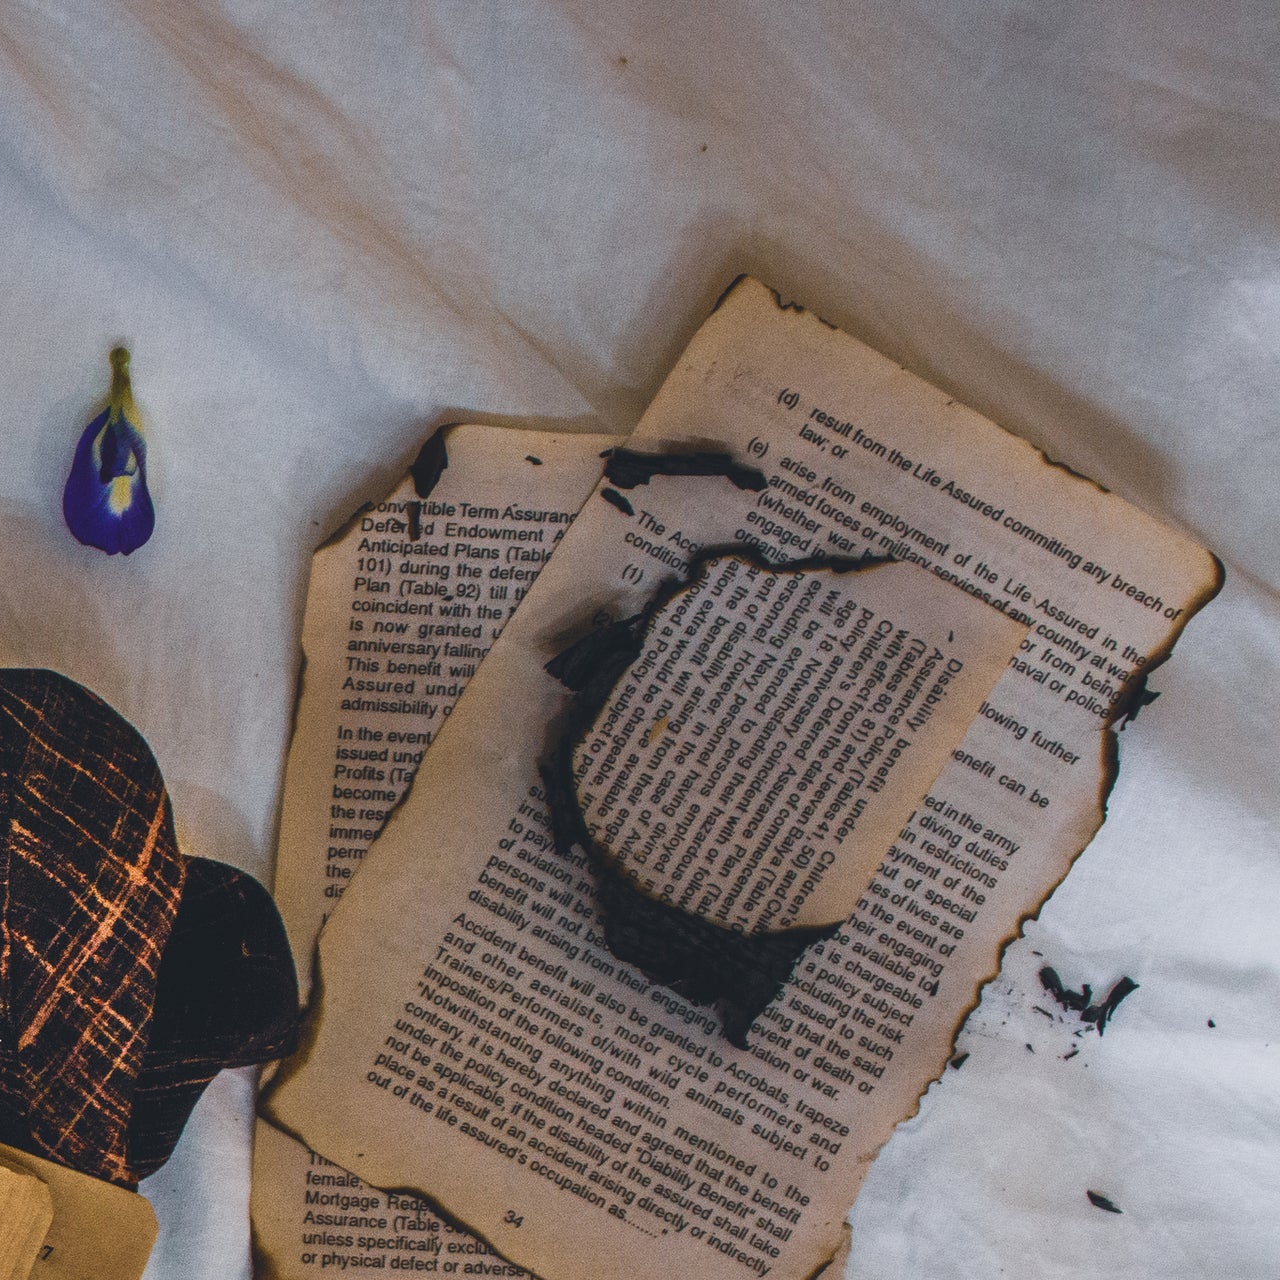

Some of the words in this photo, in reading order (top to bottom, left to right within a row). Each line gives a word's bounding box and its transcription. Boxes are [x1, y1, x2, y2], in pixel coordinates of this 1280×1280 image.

[797, 422, 831, 452] law;
[829, 443, 850, 460] or
[776, 387, 800, 411] (d)
[808, 406, 854, 438] result
[850, 427, 888, 458] from
[886, 447, 913, 472] the
[911, 462, 942, 488] Life
[939, 479, 1005, 522] Assured
[1001, 515, 1083, 570] committing
[1080, 560, 1112, 585] any
[1109, 572, 1164, 613] breach
[1162, 606, 1183, 623] of
[356, 536, 450, 559] Anticipated
[452, 541, 500, 560] Plans
[356, 556, 392, 577] 101)
[397, 558, 451, 582] during
[455, 561, 483, 580] the
[745, 435, 769, 459] (e)
[778, 456, 817, 483] arise
[819, 475, 856, 505] from
[859, 500, 950, 557] employment
[951, 552, 973, 568] of
[972, 560, 999, 585] the
[1001, 576, 1032, 603] Life
[1033, 597, 1101, 640] Assured
[1099, 635, 1118, 652] in
[1120, 644, 1146, 671] the
[800, 618, 824, 641] be
[816, 589, 842, 617] will
[344, 655, 380, 673] This
[384, 658, 442, 677] benefit
[447, 662, 476, 683] will
[751, 645, 803, 716] extended
[904, 656, 964, 733] Disability
[738, 717, 759, 735] to
[698, 735, 742, 798] persons
[864, 736, 912, 794] benefit
[651, 802, 701, 875] employed
[832, 797, 869, 845] under
[778, 849, 836, 932] Children's
[442, 930, 477, 955] and
[479, 951, 525, 981] other
[527, 978, 604, 1030] aerialists,
[612, 1024, 662, 1056] motor
[666, 1053, 710, 1084] cycle
[712, 1079, 803, 1135] performers
[807, 1131, 843, 1156] and
[451, 911, 518, 955] Accident
[515, 944, 569, 983] benefit
[567, 975, 596, 997] will
[593, 991, 627, 1015] also
[627, 1006, 649, 1027] be
[647, 1021, 708, 1059] granted
[705, 1049, 724, 1068] to
[722, 1060, 790, 1109] Acrobats,
[793, 1098, 850, 1138] trapeze
[392, 1017, 439, 1049] under
[438, 1039, 464, 1063] the
[461, 1056, 509, 1090] policy
[508, 1081, 575, 1124] condition
[574, 1114, 633, 1155] headed
[754, 1215, 793, 1243] shall
[301, 1230, 354, 1248] unless
[355, 1233, 444, 1257] specifically
[501, 1208, 525, 1229] 34
[299, 1251, 318, 1265] or
[319, 1250, 387, 1271] physical
[388, 1254, 439, 1272] defect
[441, 1260, 460, 1274] or
